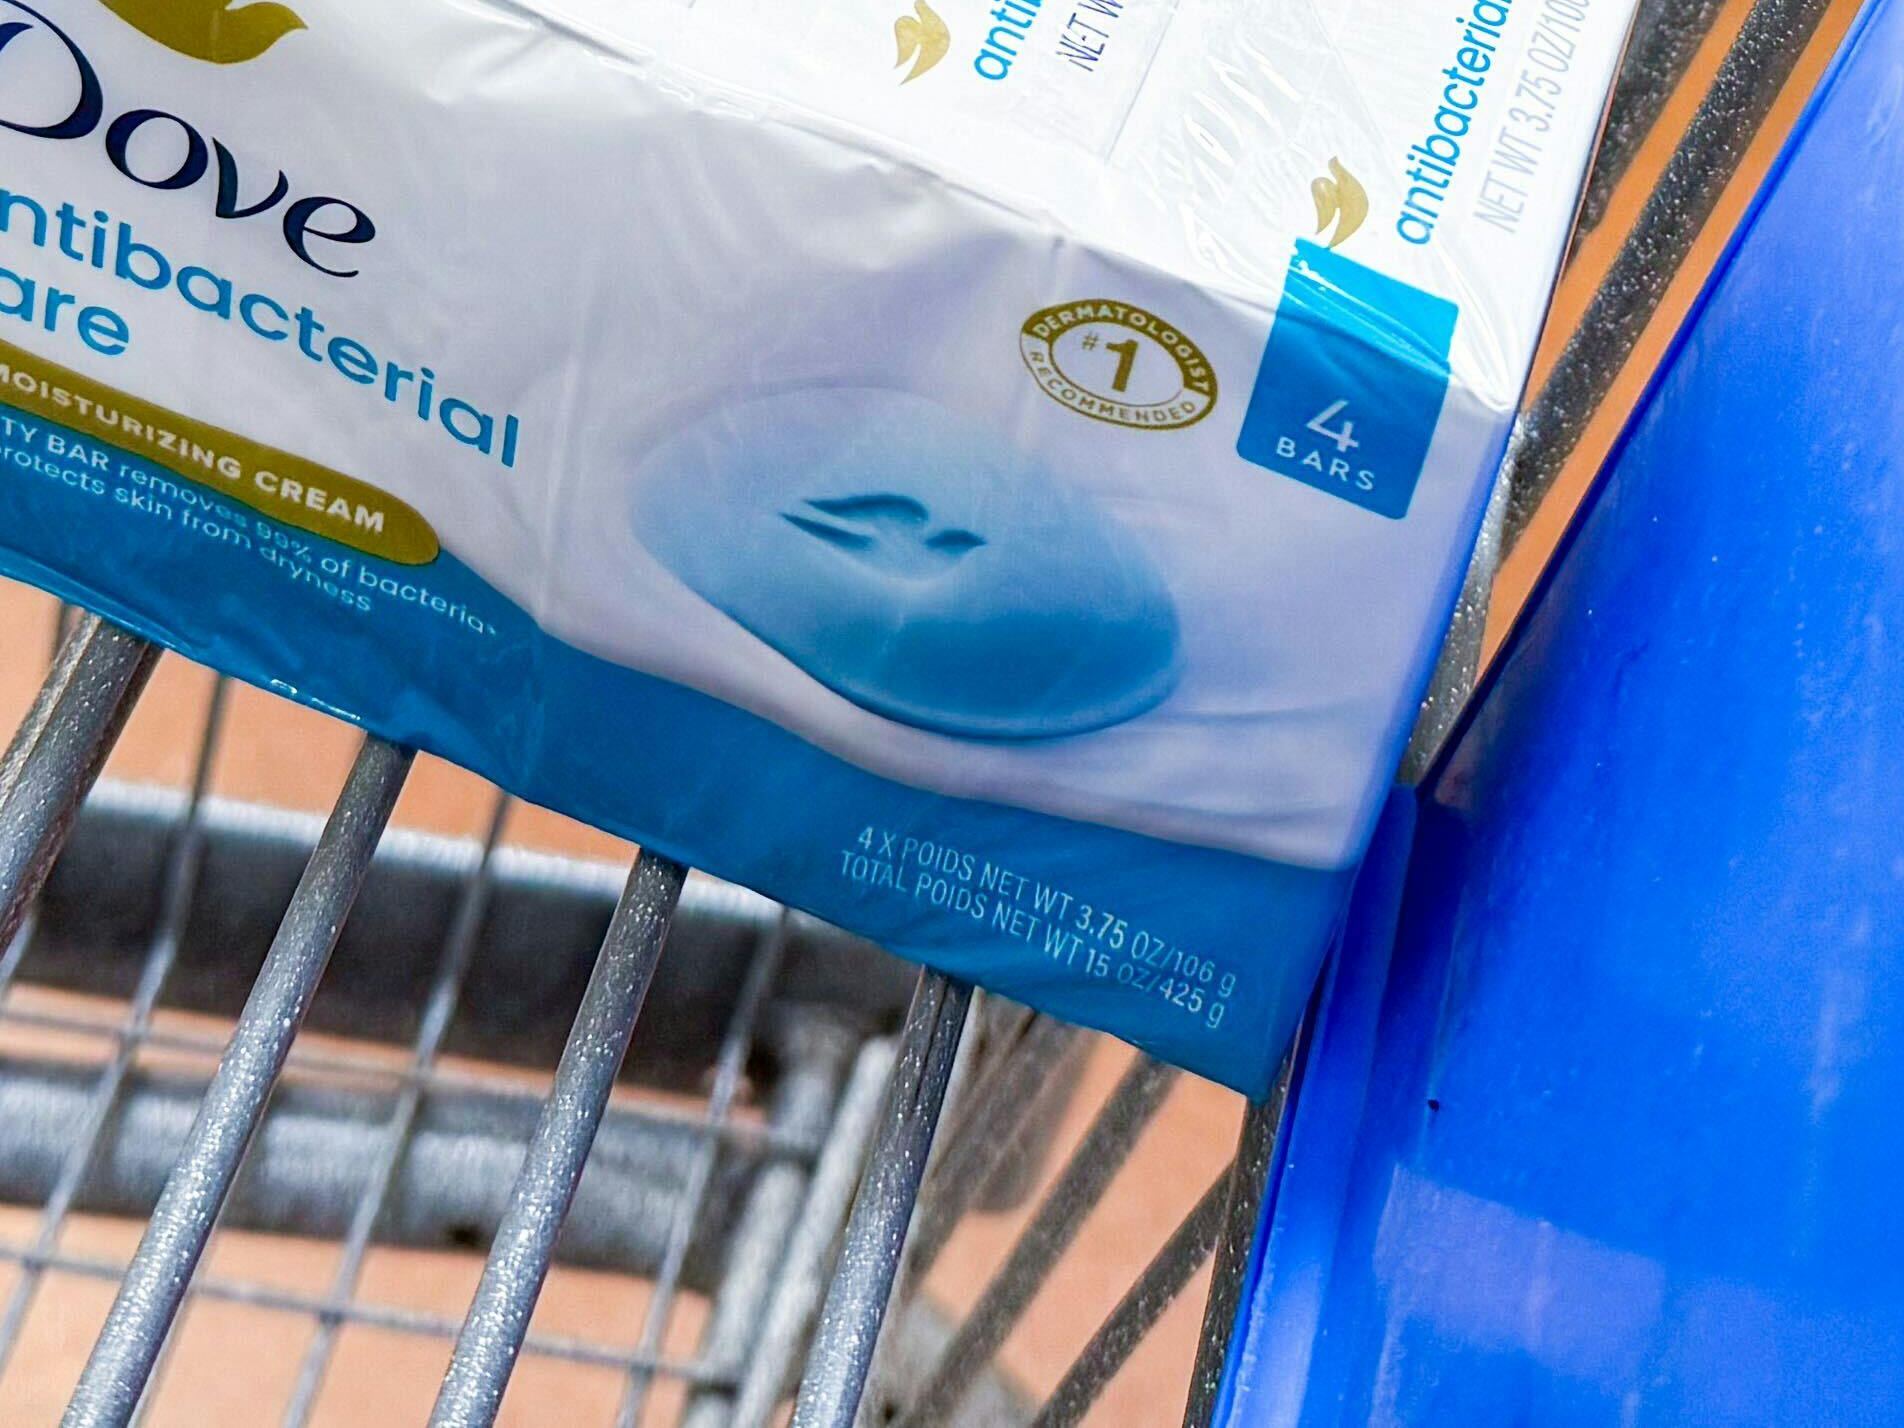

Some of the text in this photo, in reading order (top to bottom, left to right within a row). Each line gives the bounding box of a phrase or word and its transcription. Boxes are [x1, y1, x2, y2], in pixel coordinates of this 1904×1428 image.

[1055, 11, 1110, 73] NET
[1507, 68, 1563, 133] 3.75
[1490, 125, 1543, 177] WT
[1472, 169, 1529, 235] NET
[1032, 303, 1211, 393] DERMATOLOGIST
[1081, 329, 1140, 394] #1
[1029, 350, 1197, 424] RECOMMENDED
[1304, 398, 1360, 454] 4
[1276, 435, 1376, 492] BARS
[46, 433, 110, 472] BAR
[118, 461, 247, 530] removes
[320, 554, 351, 579] of
[253, 470, 385, 534] CREAM
[113, 483, 174, 521] skin
[180, 509, 252, 551] from
[258, 544, 373, 613] dryness
[840, 849, 1226, 1030] TOTAL POIDS NET WT 15 OZ/425 g
[857, 825, 1238, 999] 4 X POIDS NET WT 3.75 OZ/106 g
